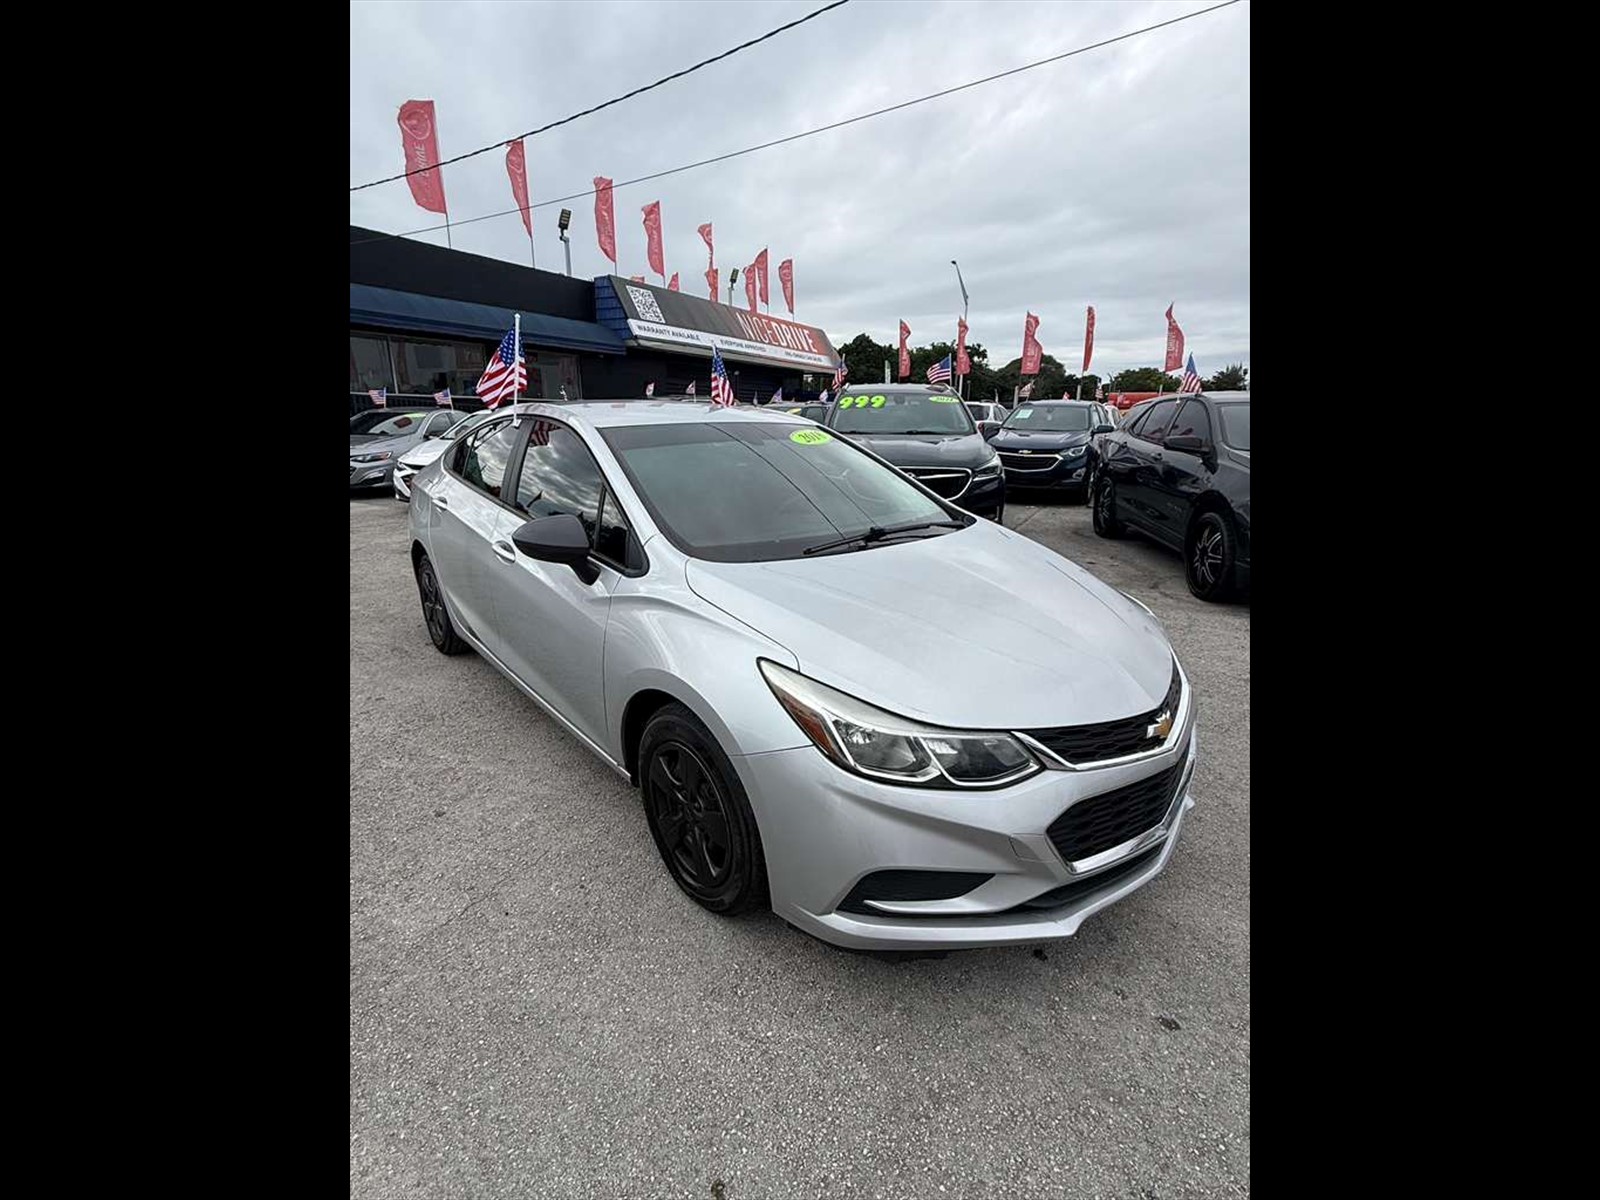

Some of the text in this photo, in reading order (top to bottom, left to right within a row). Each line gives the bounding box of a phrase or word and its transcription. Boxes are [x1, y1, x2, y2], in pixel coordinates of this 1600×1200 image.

[636, 325, 701, 340] WARRANTY AVAILABLE
[735, 311, 818, 353] NICEDRIVE
[839, 395, 886, 410] 999
